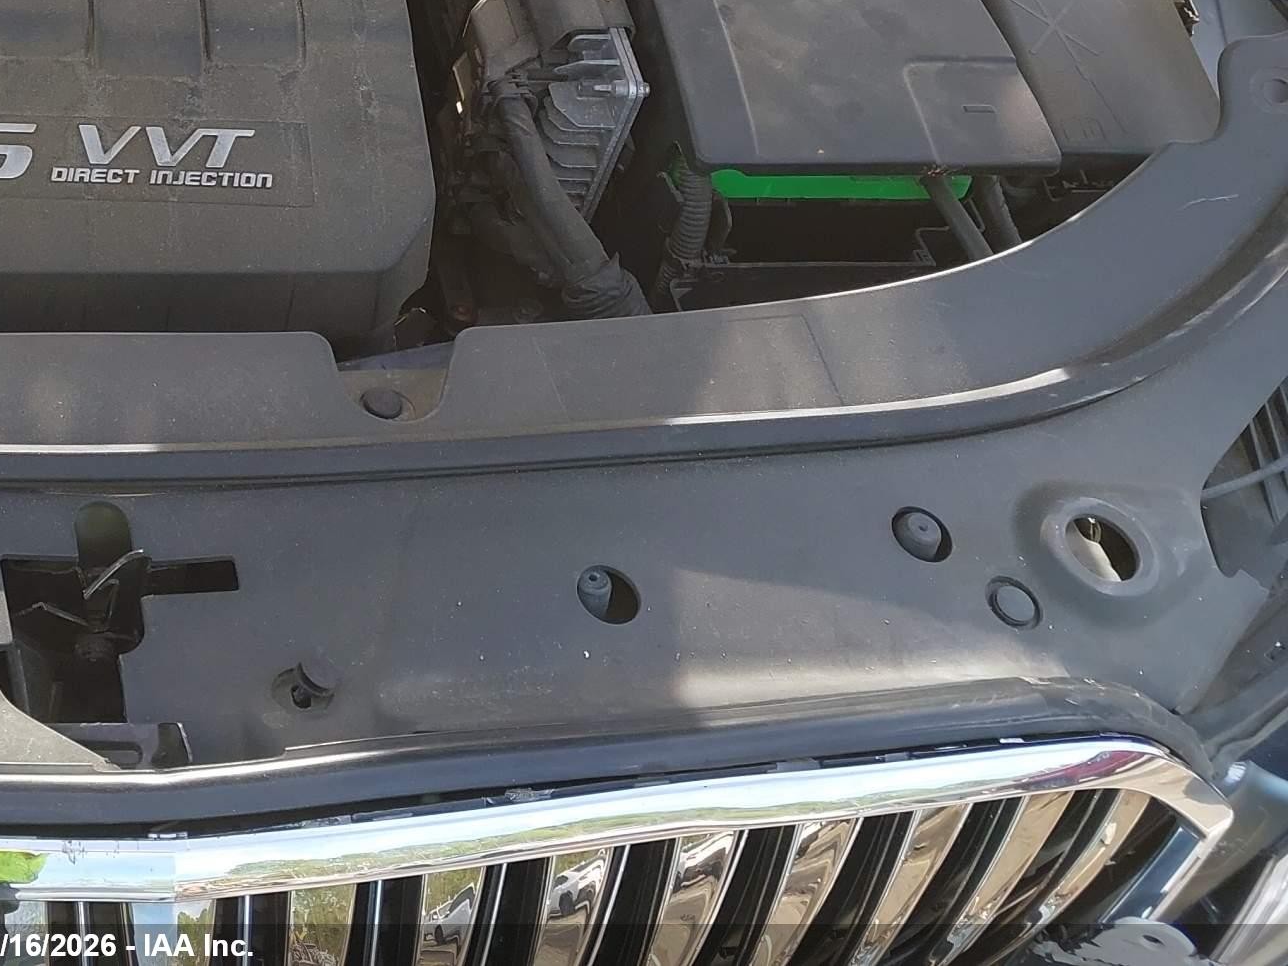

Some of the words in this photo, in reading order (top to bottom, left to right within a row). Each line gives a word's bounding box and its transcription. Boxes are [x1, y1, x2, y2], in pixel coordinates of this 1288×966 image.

[78, 124, 255, 168] VVT
[50, 166, 140, 184] DIRECT
[149, 169, 273, 188] INJECTION
